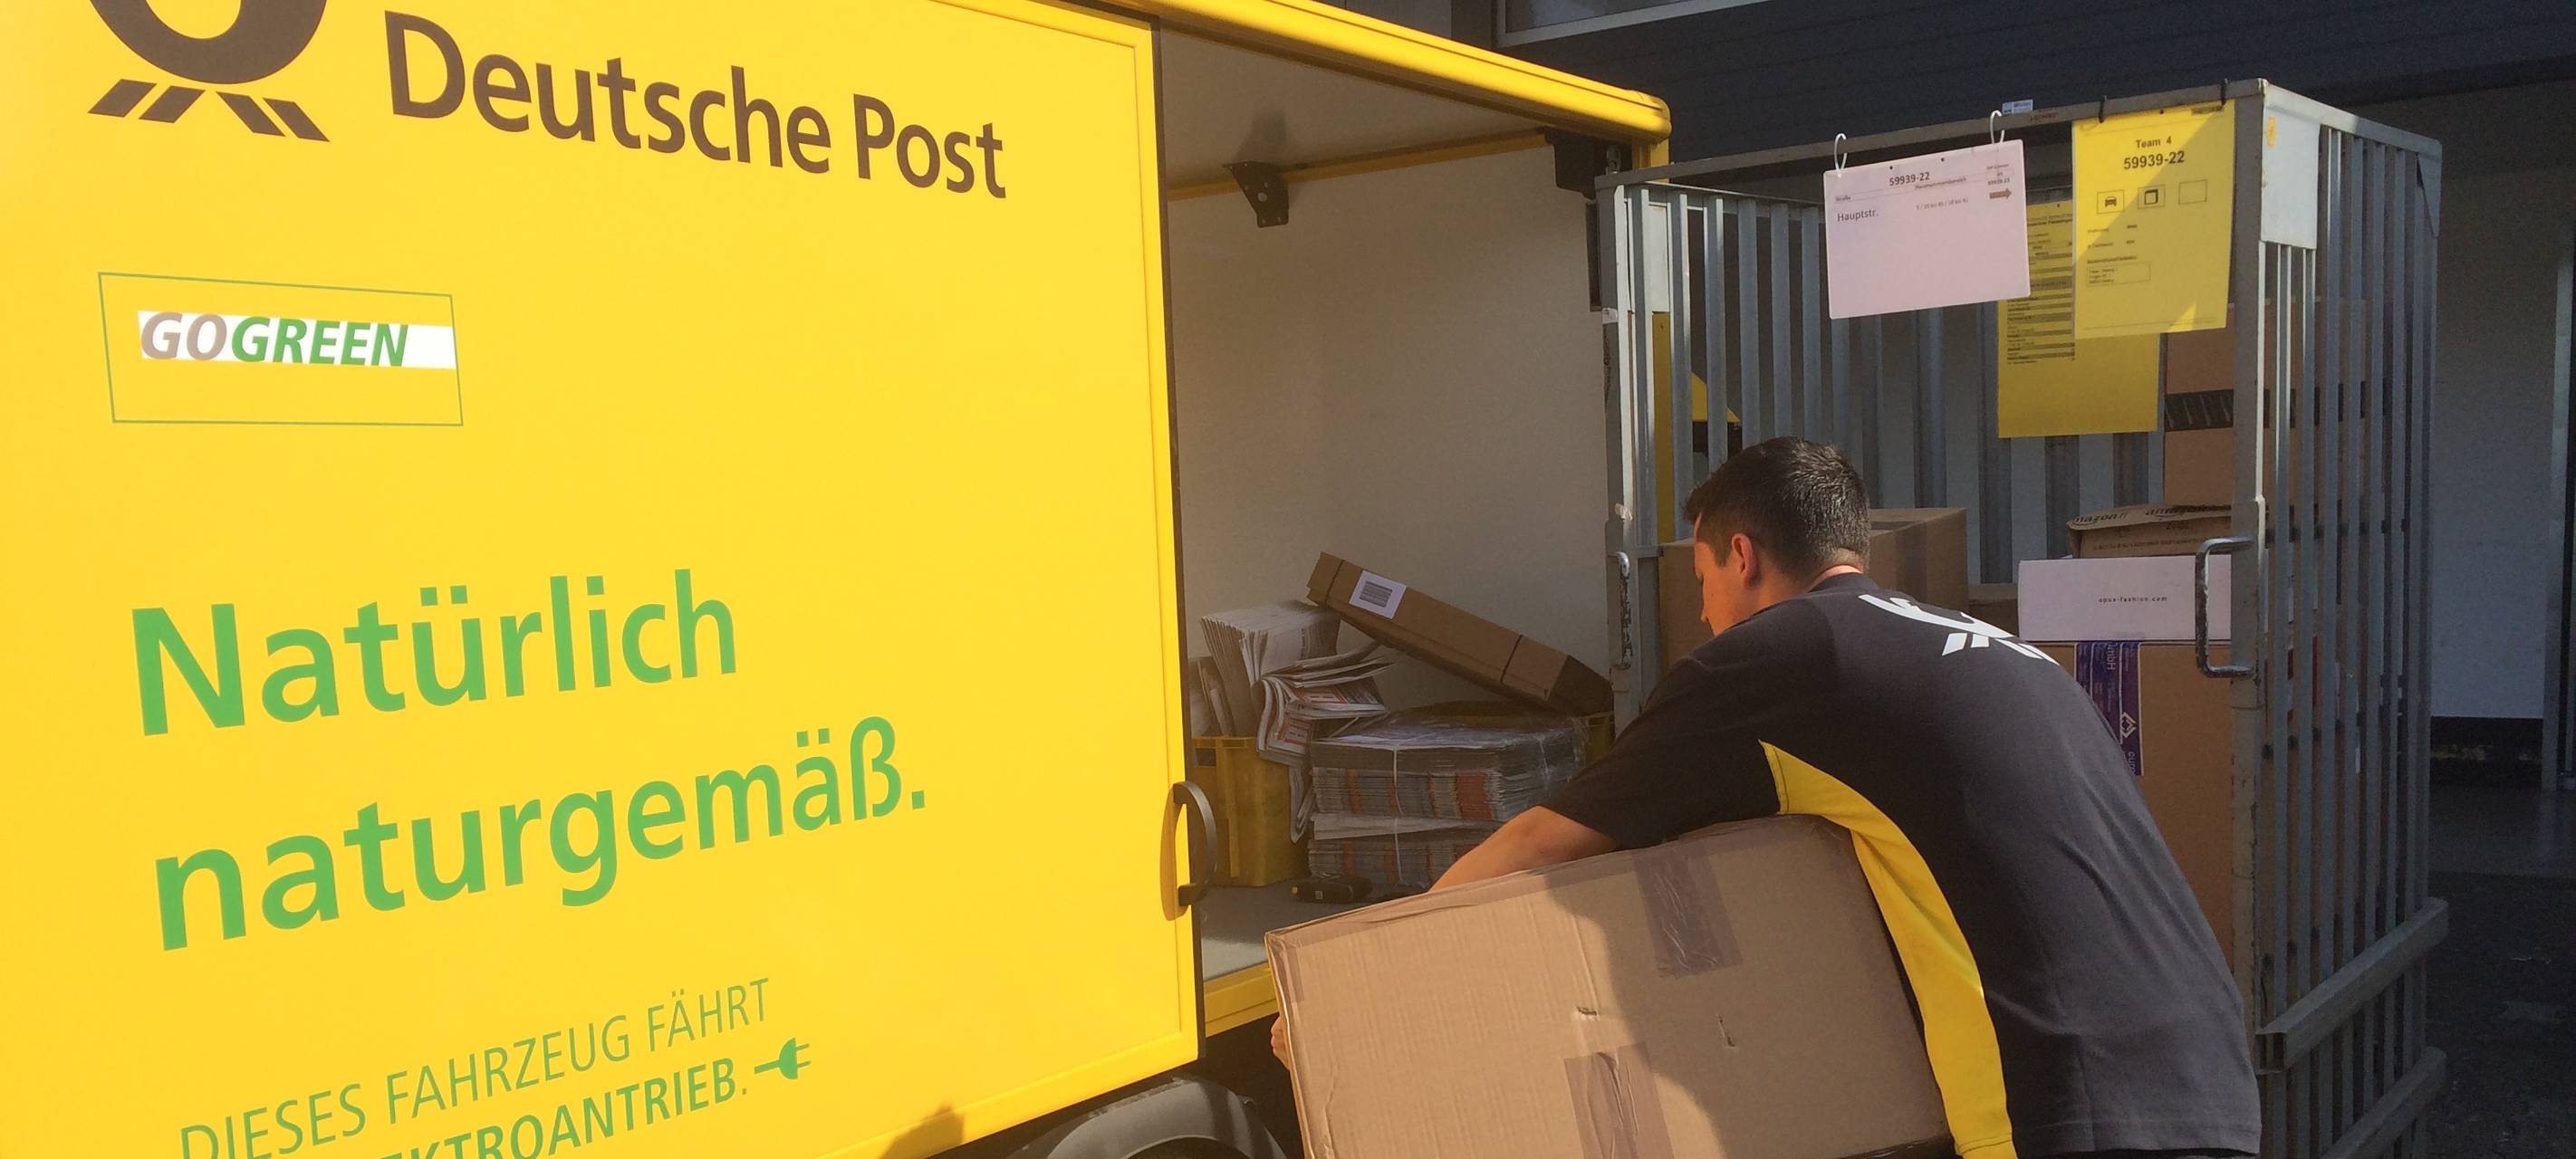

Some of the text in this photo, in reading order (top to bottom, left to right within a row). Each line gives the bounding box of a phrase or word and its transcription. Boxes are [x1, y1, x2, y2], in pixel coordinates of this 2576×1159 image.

[384, 11, 1006, 198] Deutsche Post
[2123, 150, 2185, 170] 59939-22
[2135, 135, 2172, 148] Team 4
[1889, 171, 1930, 187] 59939-22
[1837, 209, 1879, 222] Hauptstr.
[140, 311, 409, 367] GOGREEN
[131, 568, 736, 736] Natürlich
[155, 715, 926, 951] naturgemäß.
[181, 977, 769, 1159] DIESES FAHRZEUG FÄHRT
